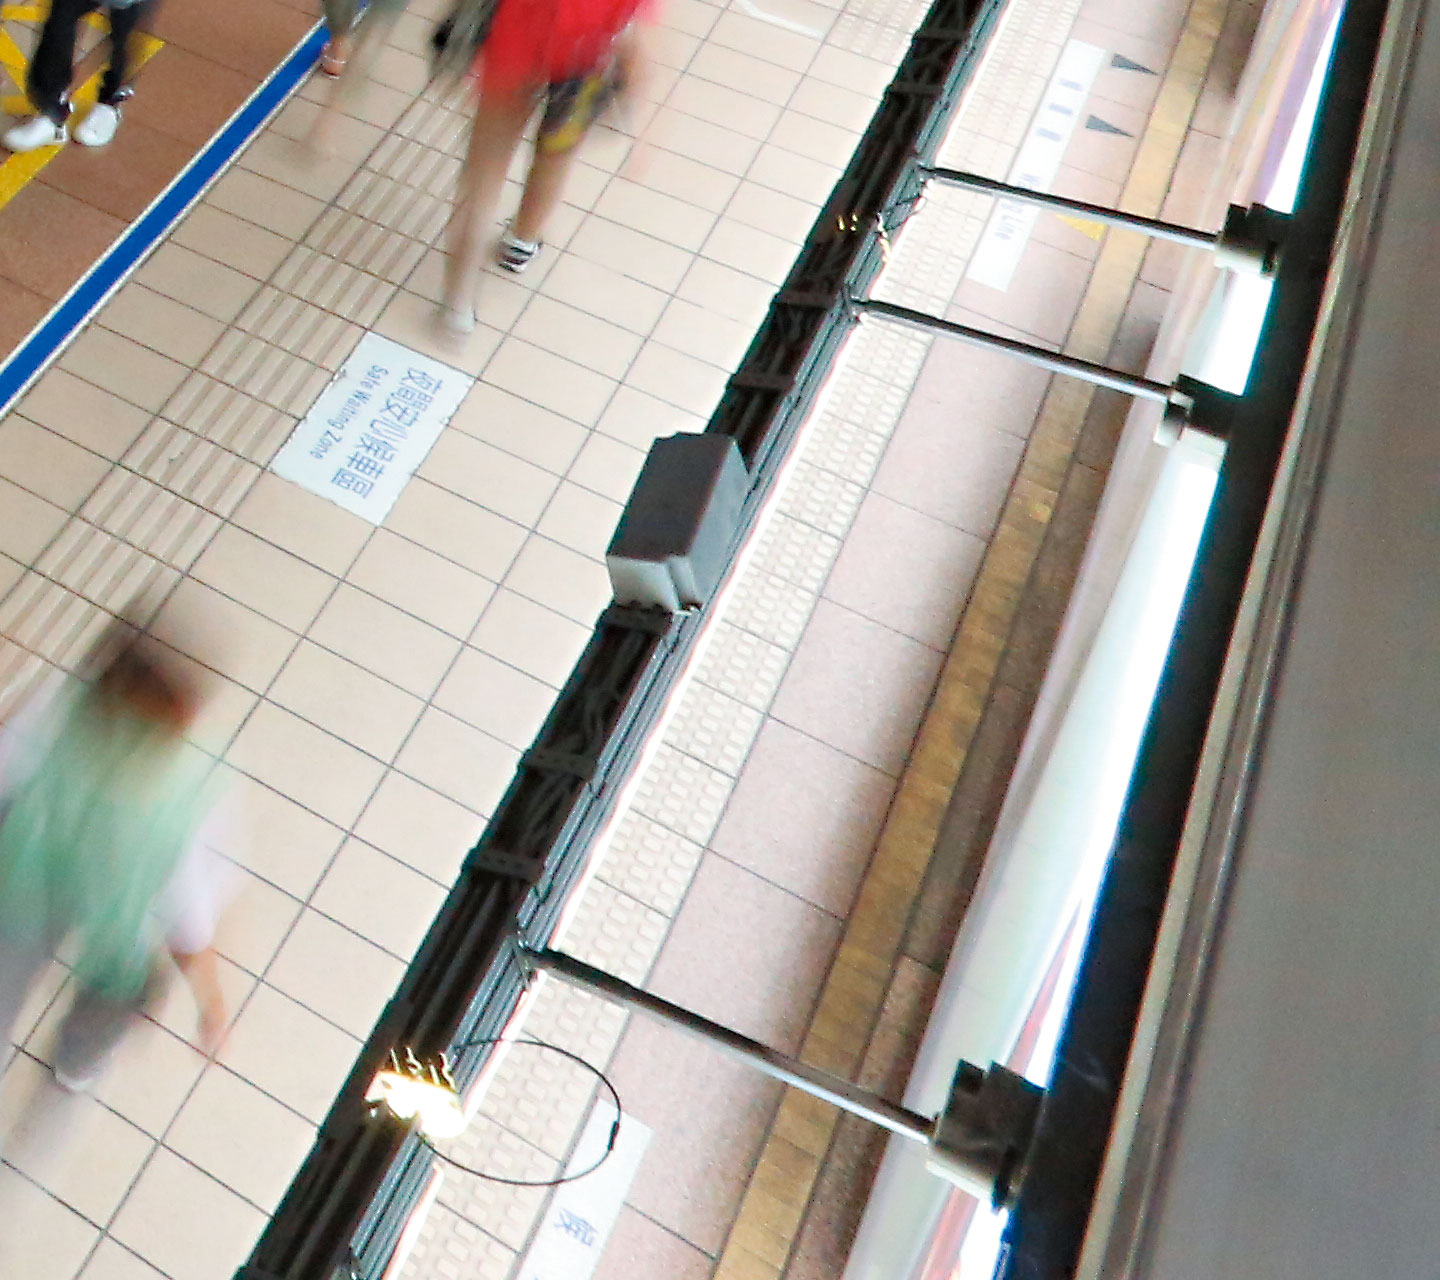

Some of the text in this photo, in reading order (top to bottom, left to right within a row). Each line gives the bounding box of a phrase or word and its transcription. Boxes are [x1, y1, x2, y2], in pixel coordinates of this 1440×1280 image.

[309, 365, 389, 461] Safe Waiting Zone
[330, 366, 444, 500] 夜間安心候車區
